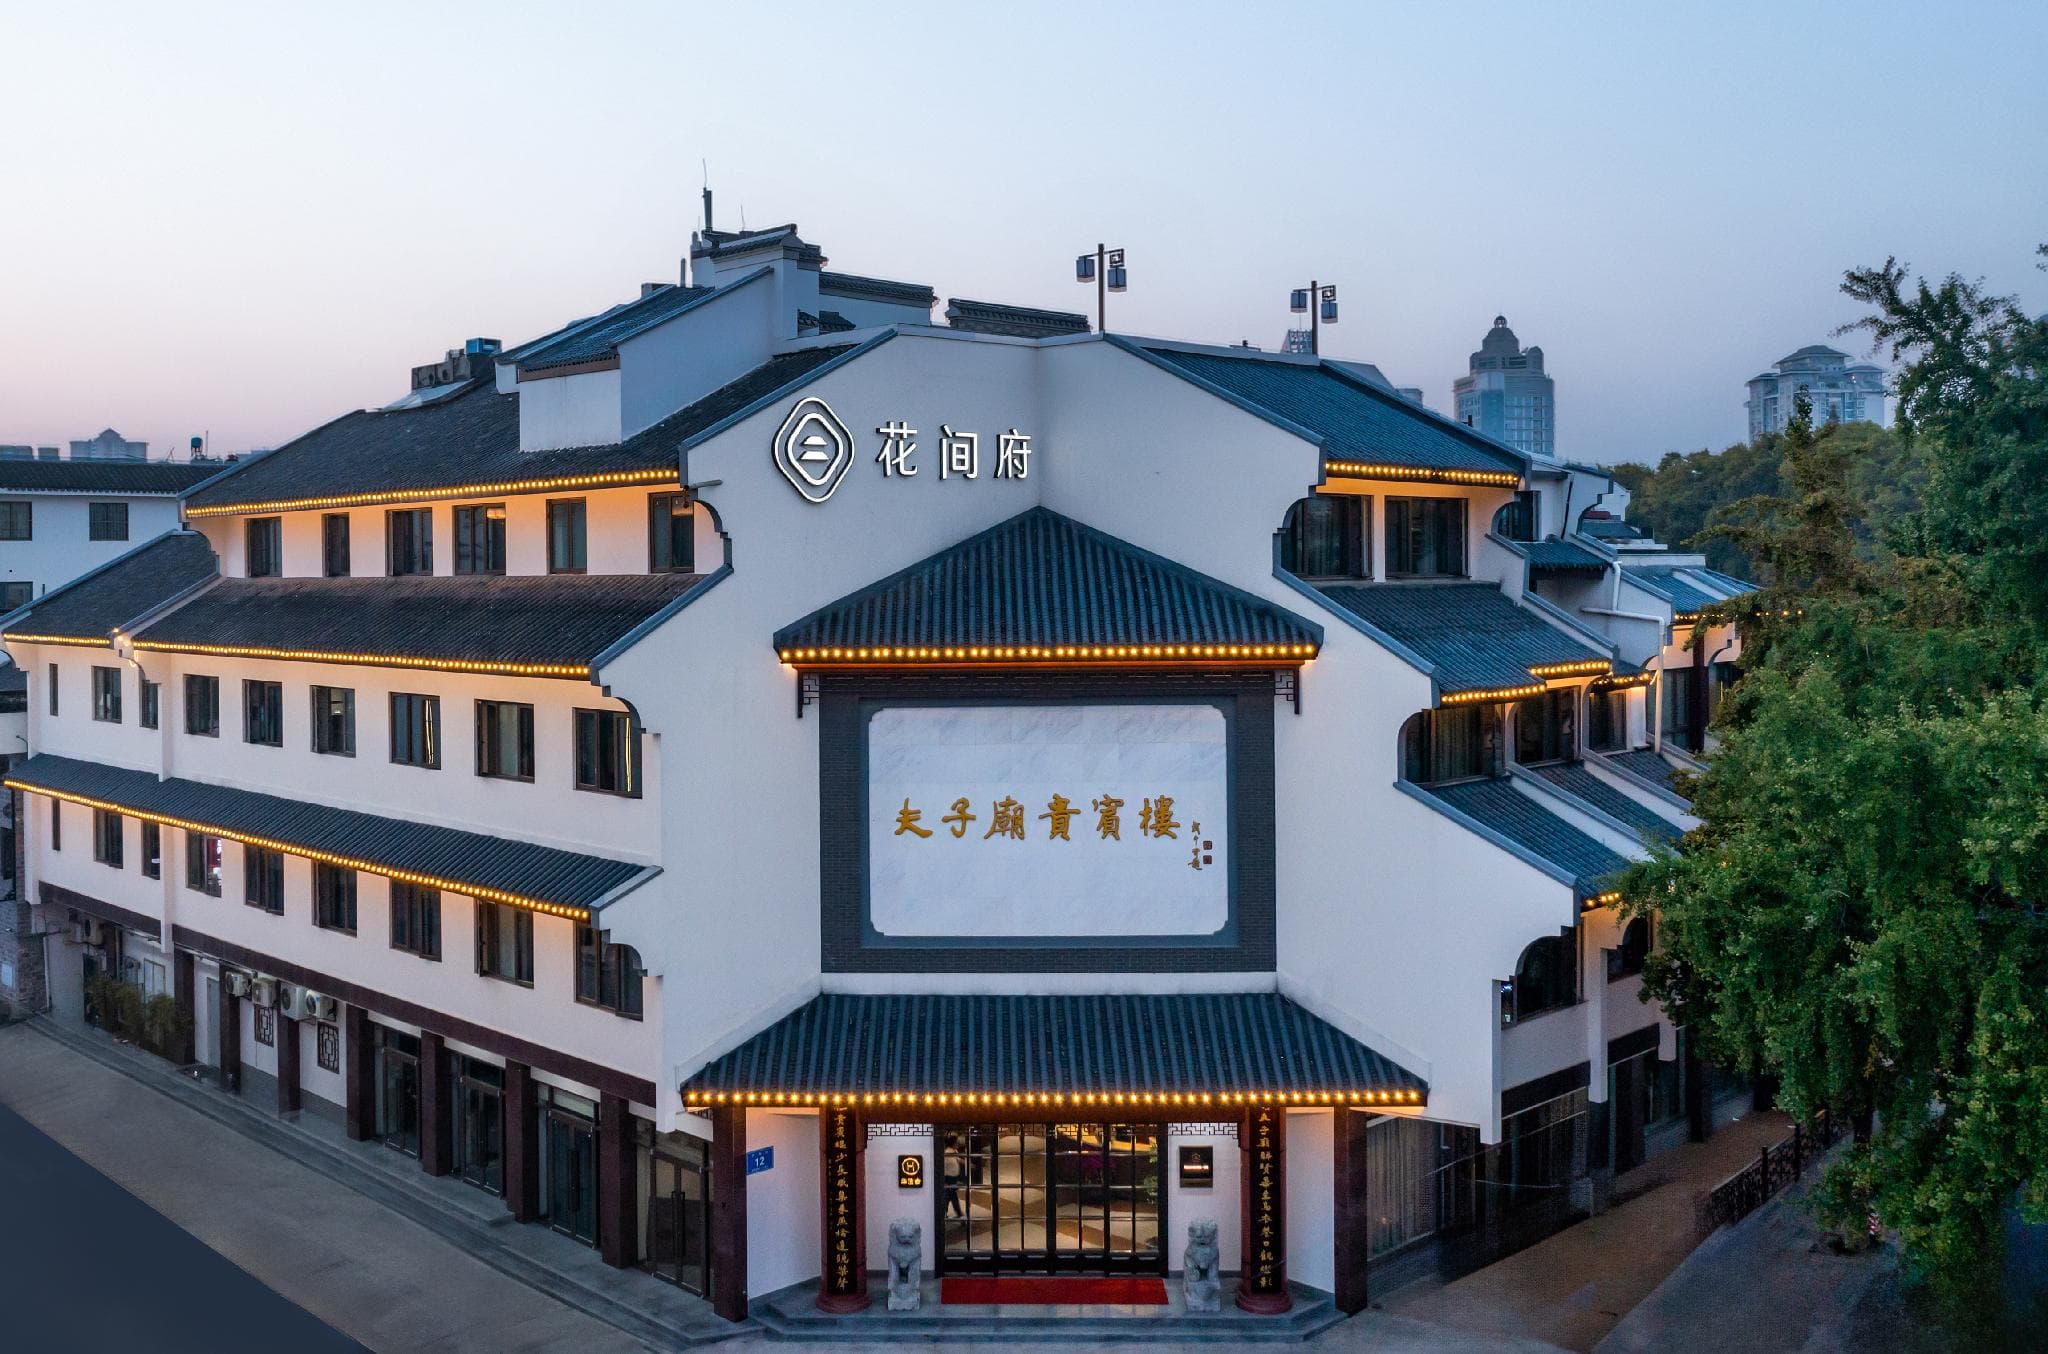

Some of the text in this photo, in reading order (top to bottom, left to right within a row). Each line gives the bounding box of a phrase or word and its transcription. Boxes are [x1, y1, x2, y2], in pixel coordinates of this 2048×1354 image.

[876, 421, 1032, 480] 花间府
[894, 793, 1182, 841] 夫子廟貴賓樓
[754, 1155, 766, 1168] 12
